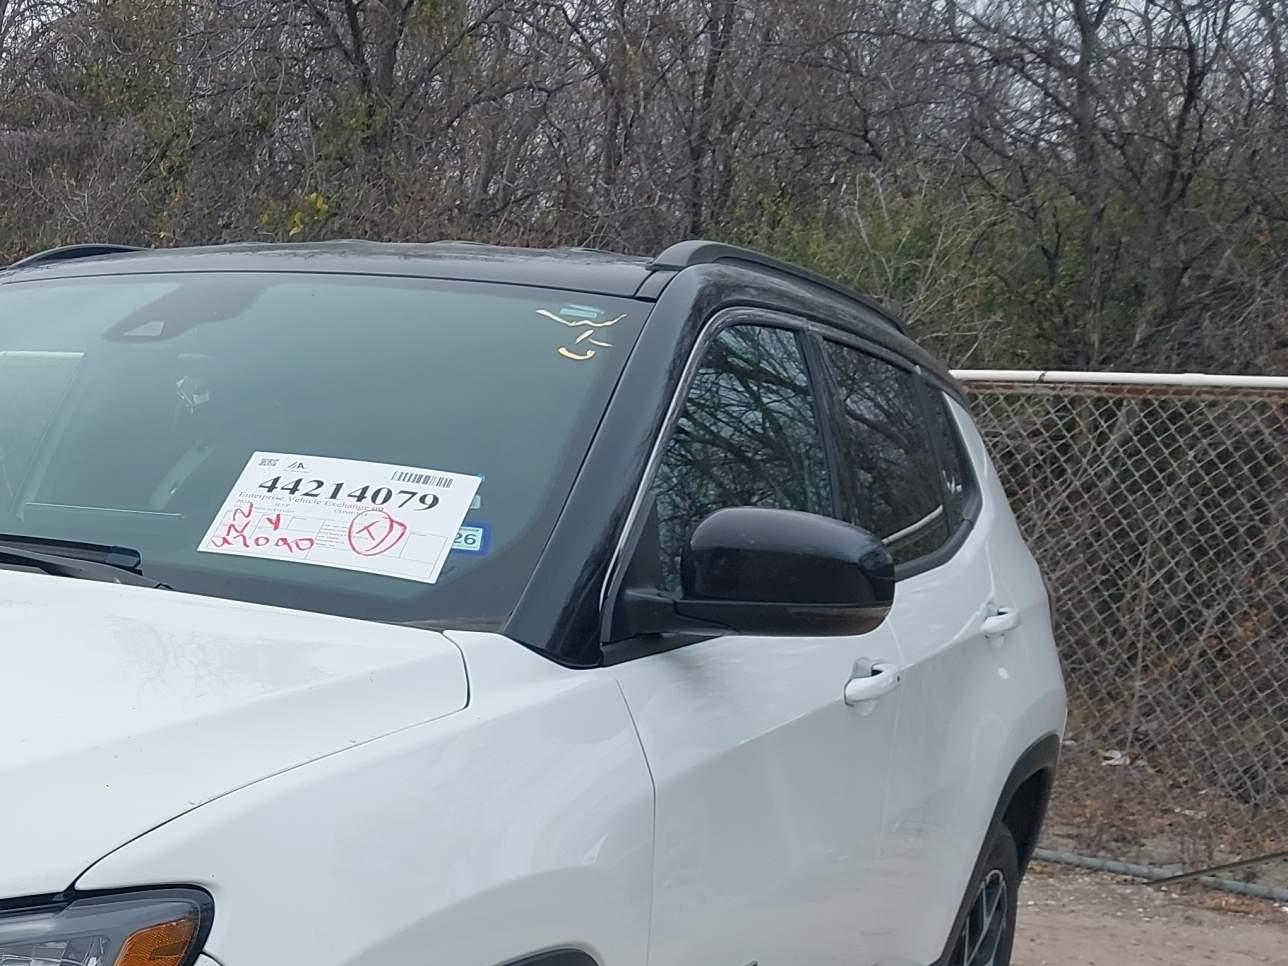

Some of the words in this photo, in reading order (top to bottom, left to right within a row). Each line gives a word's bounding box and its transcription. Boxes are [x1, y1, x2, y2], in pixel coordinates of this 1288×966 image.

[238, 491, 285, 502] Enterprise
[288, 496, 322, 506] Vehicle
[257, 475, 440, 512] 44214079
[453, 532, 477, 546] 26
